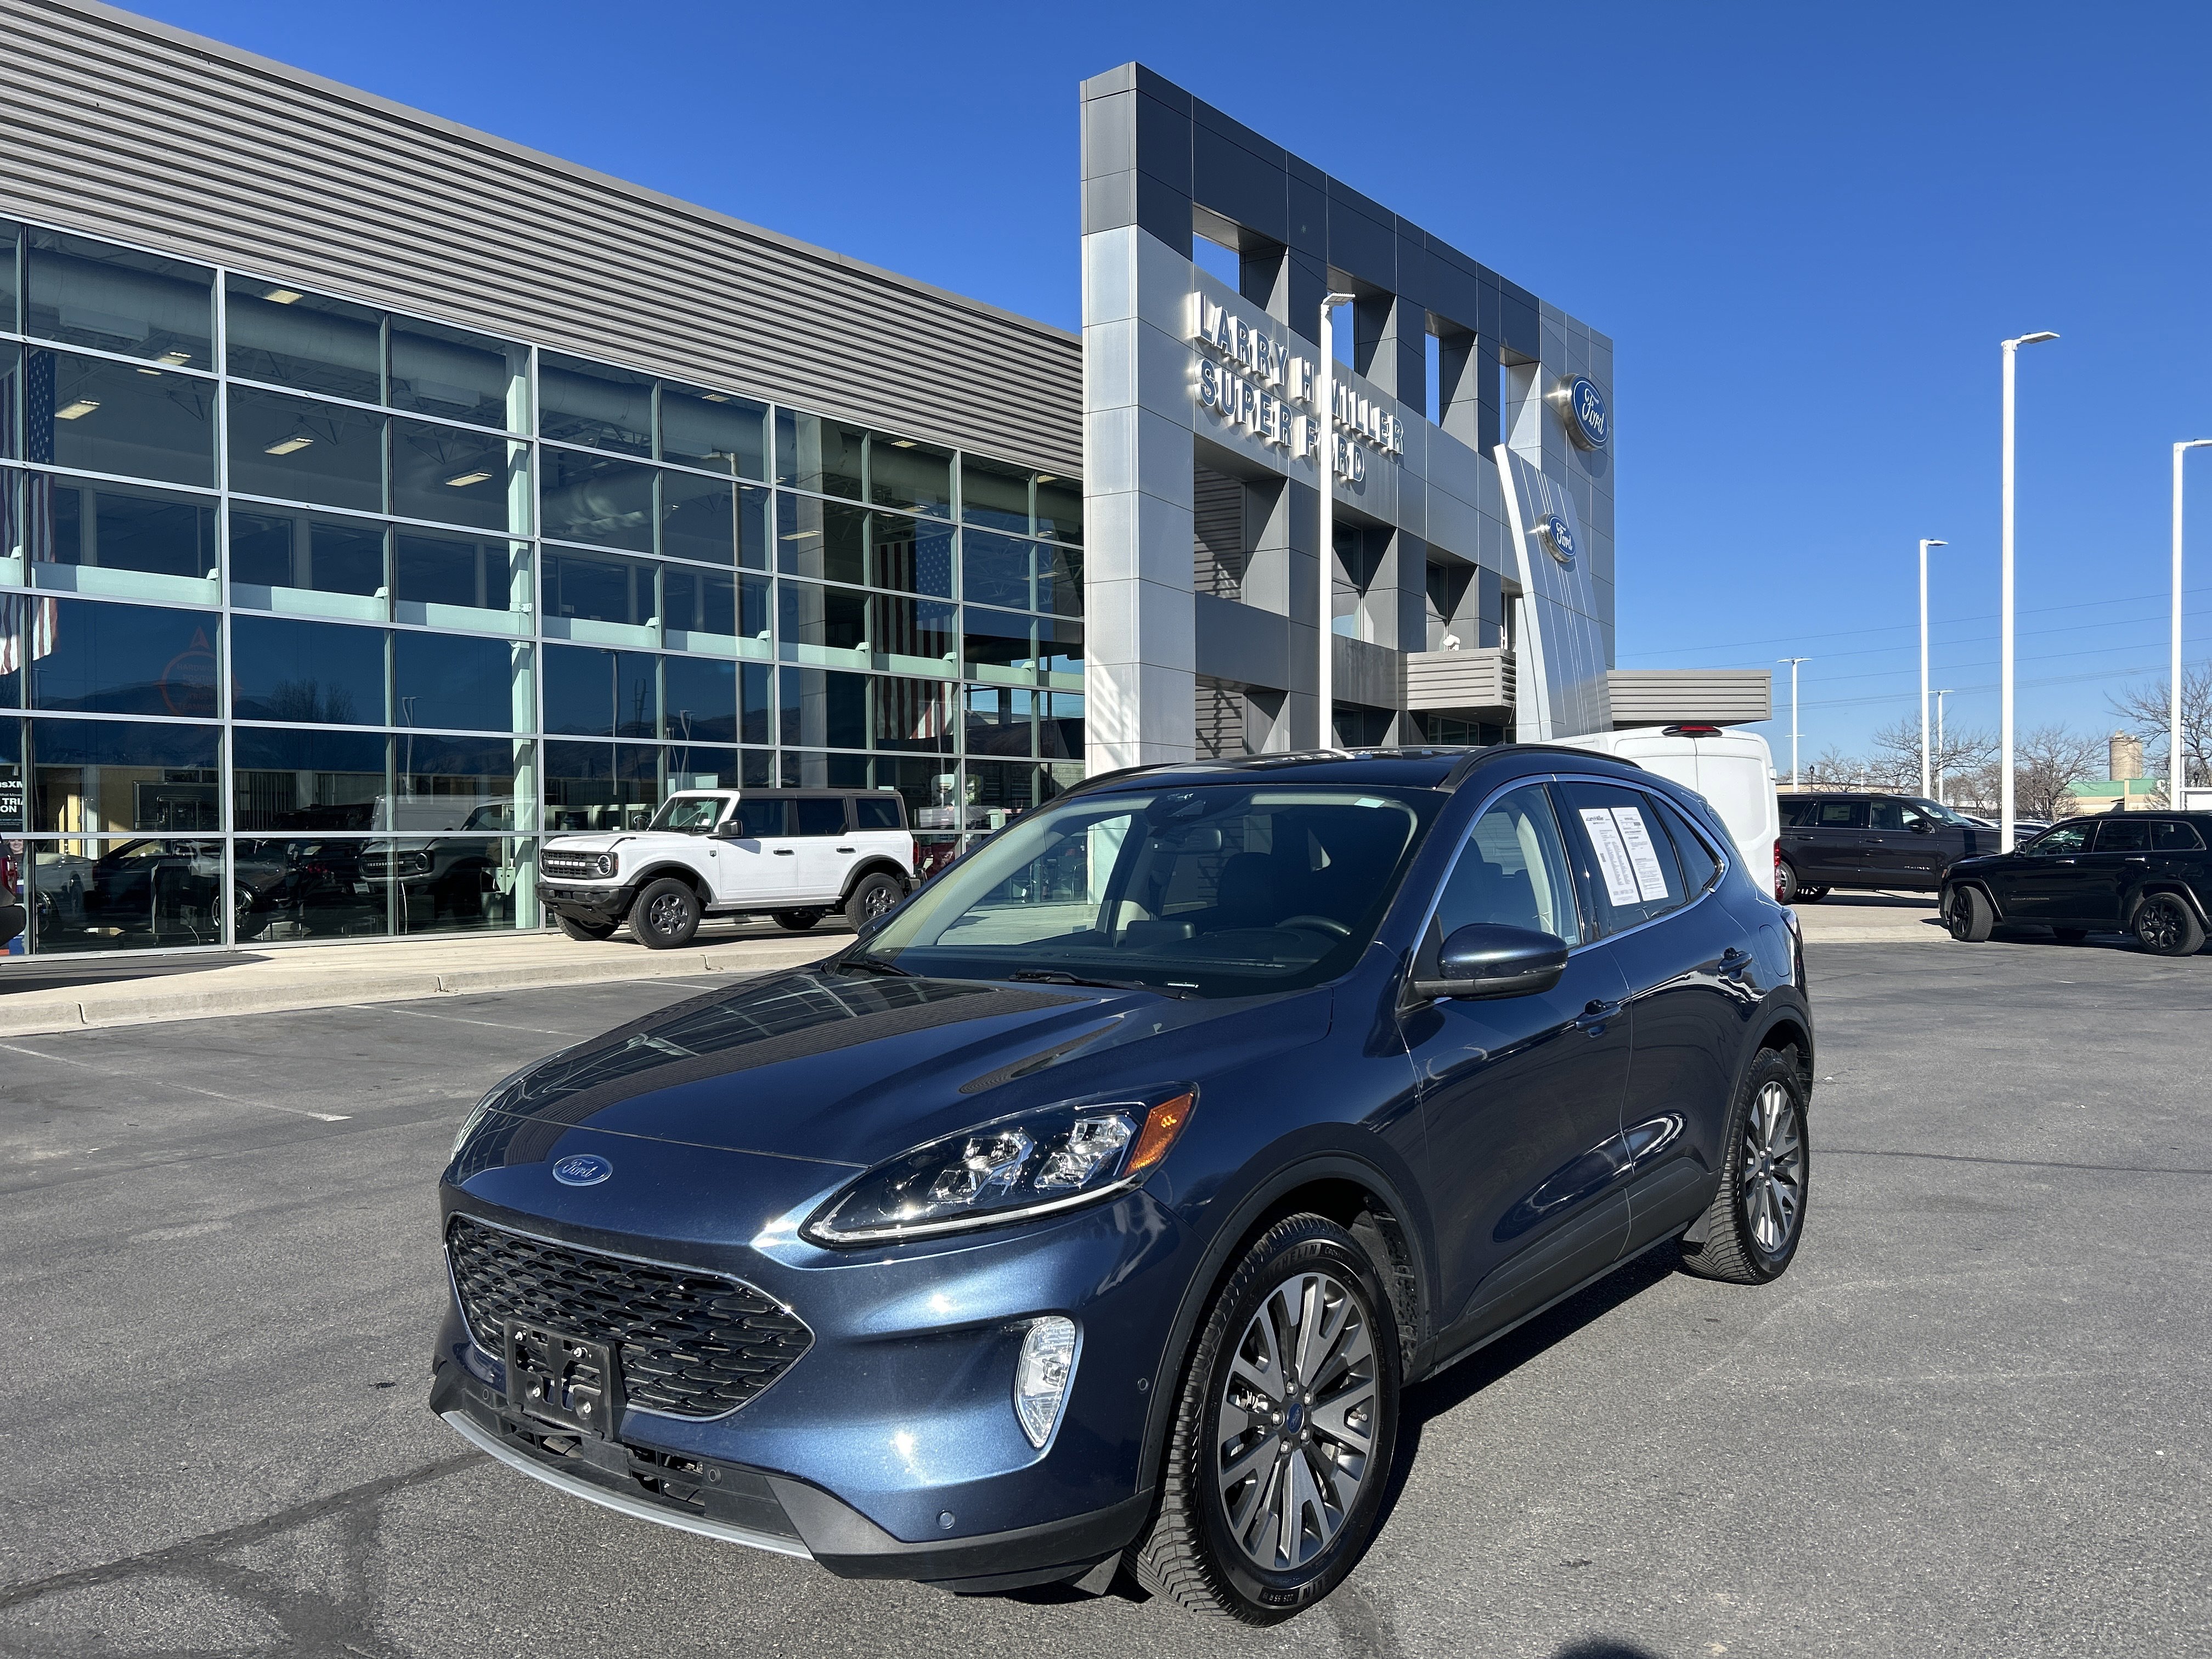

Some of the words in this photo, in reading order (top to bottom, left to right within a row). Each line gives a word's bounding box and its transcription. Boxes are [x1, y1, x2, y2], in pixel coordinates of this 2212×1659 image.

[1194, 291, 1289, 386] LARRY
[1296, 357, 1314, 403] H
[1195, 358, 1293, 447] SUPER
[1297, 415, 1365, 482] FRD
[1582, 388, 1605, 435] Ford
[1556, 522, 1573, 551] Ford
[562, 1159, 598, 1178] Ford
